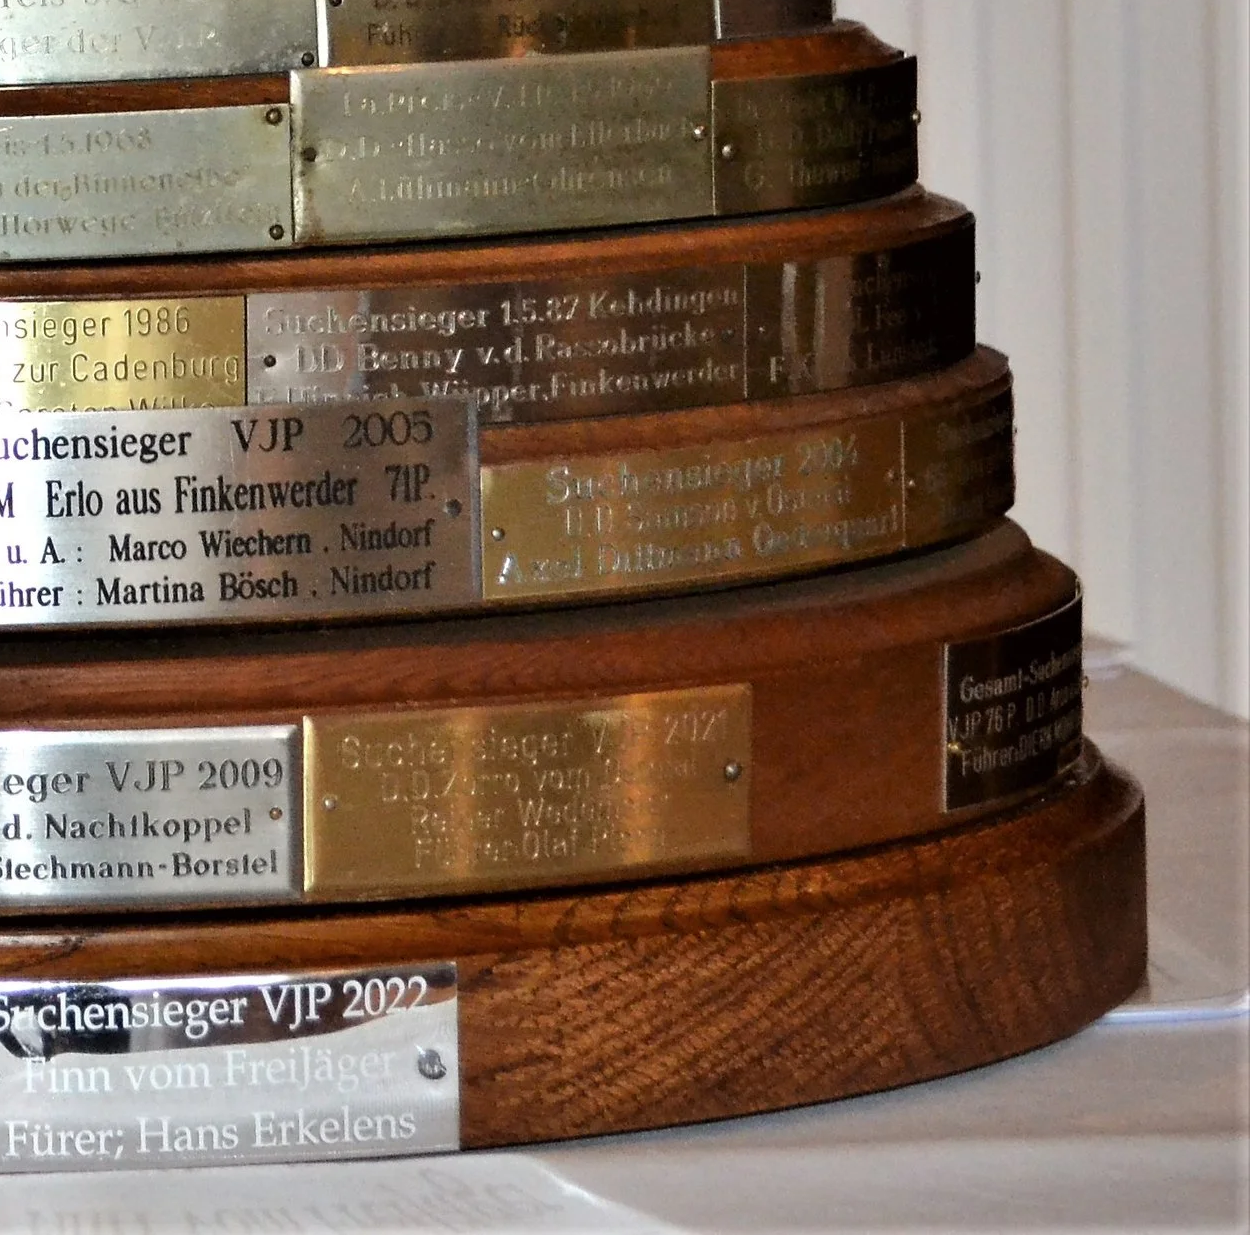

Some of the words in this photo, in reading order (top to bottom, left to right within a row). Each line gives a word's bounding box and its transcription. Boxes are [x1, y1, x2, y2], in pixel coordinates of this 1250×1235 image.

[123, 306, 191, 337] 1986
[264, 304, 492, 337] Suchensieger
[12, 360, 60, 384] zur
[71, 352, 241, 386] Cadenburg
[356, 339, 465, 375] Benny
[231, 418, 304, 453] VJP
[343, 409, 434, 448] 2005
[45, 478, 104, 517] Erlo
[115, 487, 162, 516] aus
[173, 474, 359, 514] Finkenwerder
[107, 533, 187, 563] Marco
[198, 525, 312, 559] Wiechern
[340, 518, 437, 552] Nindorf
[96, 574, 205, 607] Martina
[218, 568, 299, 601] Bösch
[330, 562, 437, 596] Nindorf
[105, 759, 185, 793] VJP
[196, 757, 284, 791] 2009
[44, 807, 252, 848] Nachtkoppel
[257, 980, 335, 1033] VJP
[341, 975, 429, 1018] 2022
[21, 1055, 113, 1095] Finn
[124, 1059, 212, 1093] vom
[4, 1119, 125, 1160] Fürer;
[136, 1116, 240, 1154] Hans
[250, 1104, 418, 1150] Erkelens
